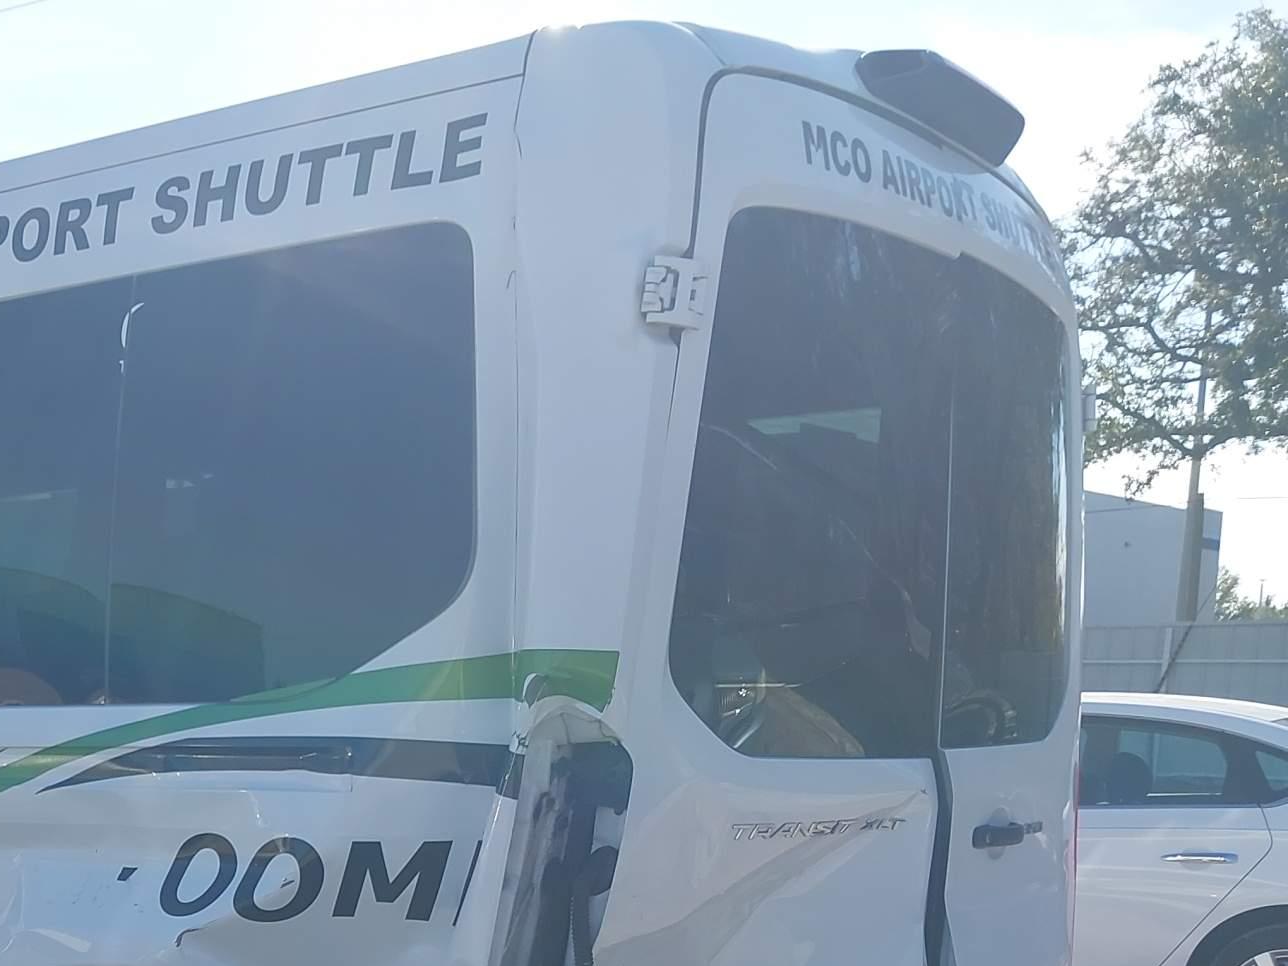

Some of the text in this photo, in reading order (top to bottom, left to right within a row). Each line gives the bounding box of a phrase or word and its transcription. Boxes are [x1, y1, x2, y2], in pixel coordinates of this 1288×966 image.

[151, 112, 489, 236] SHUTTLE
[801, 120, 872, 183] MCO
[881, 149, 979, 224] AIRPORT
[731, 818, 859, 841] TRANSIT
